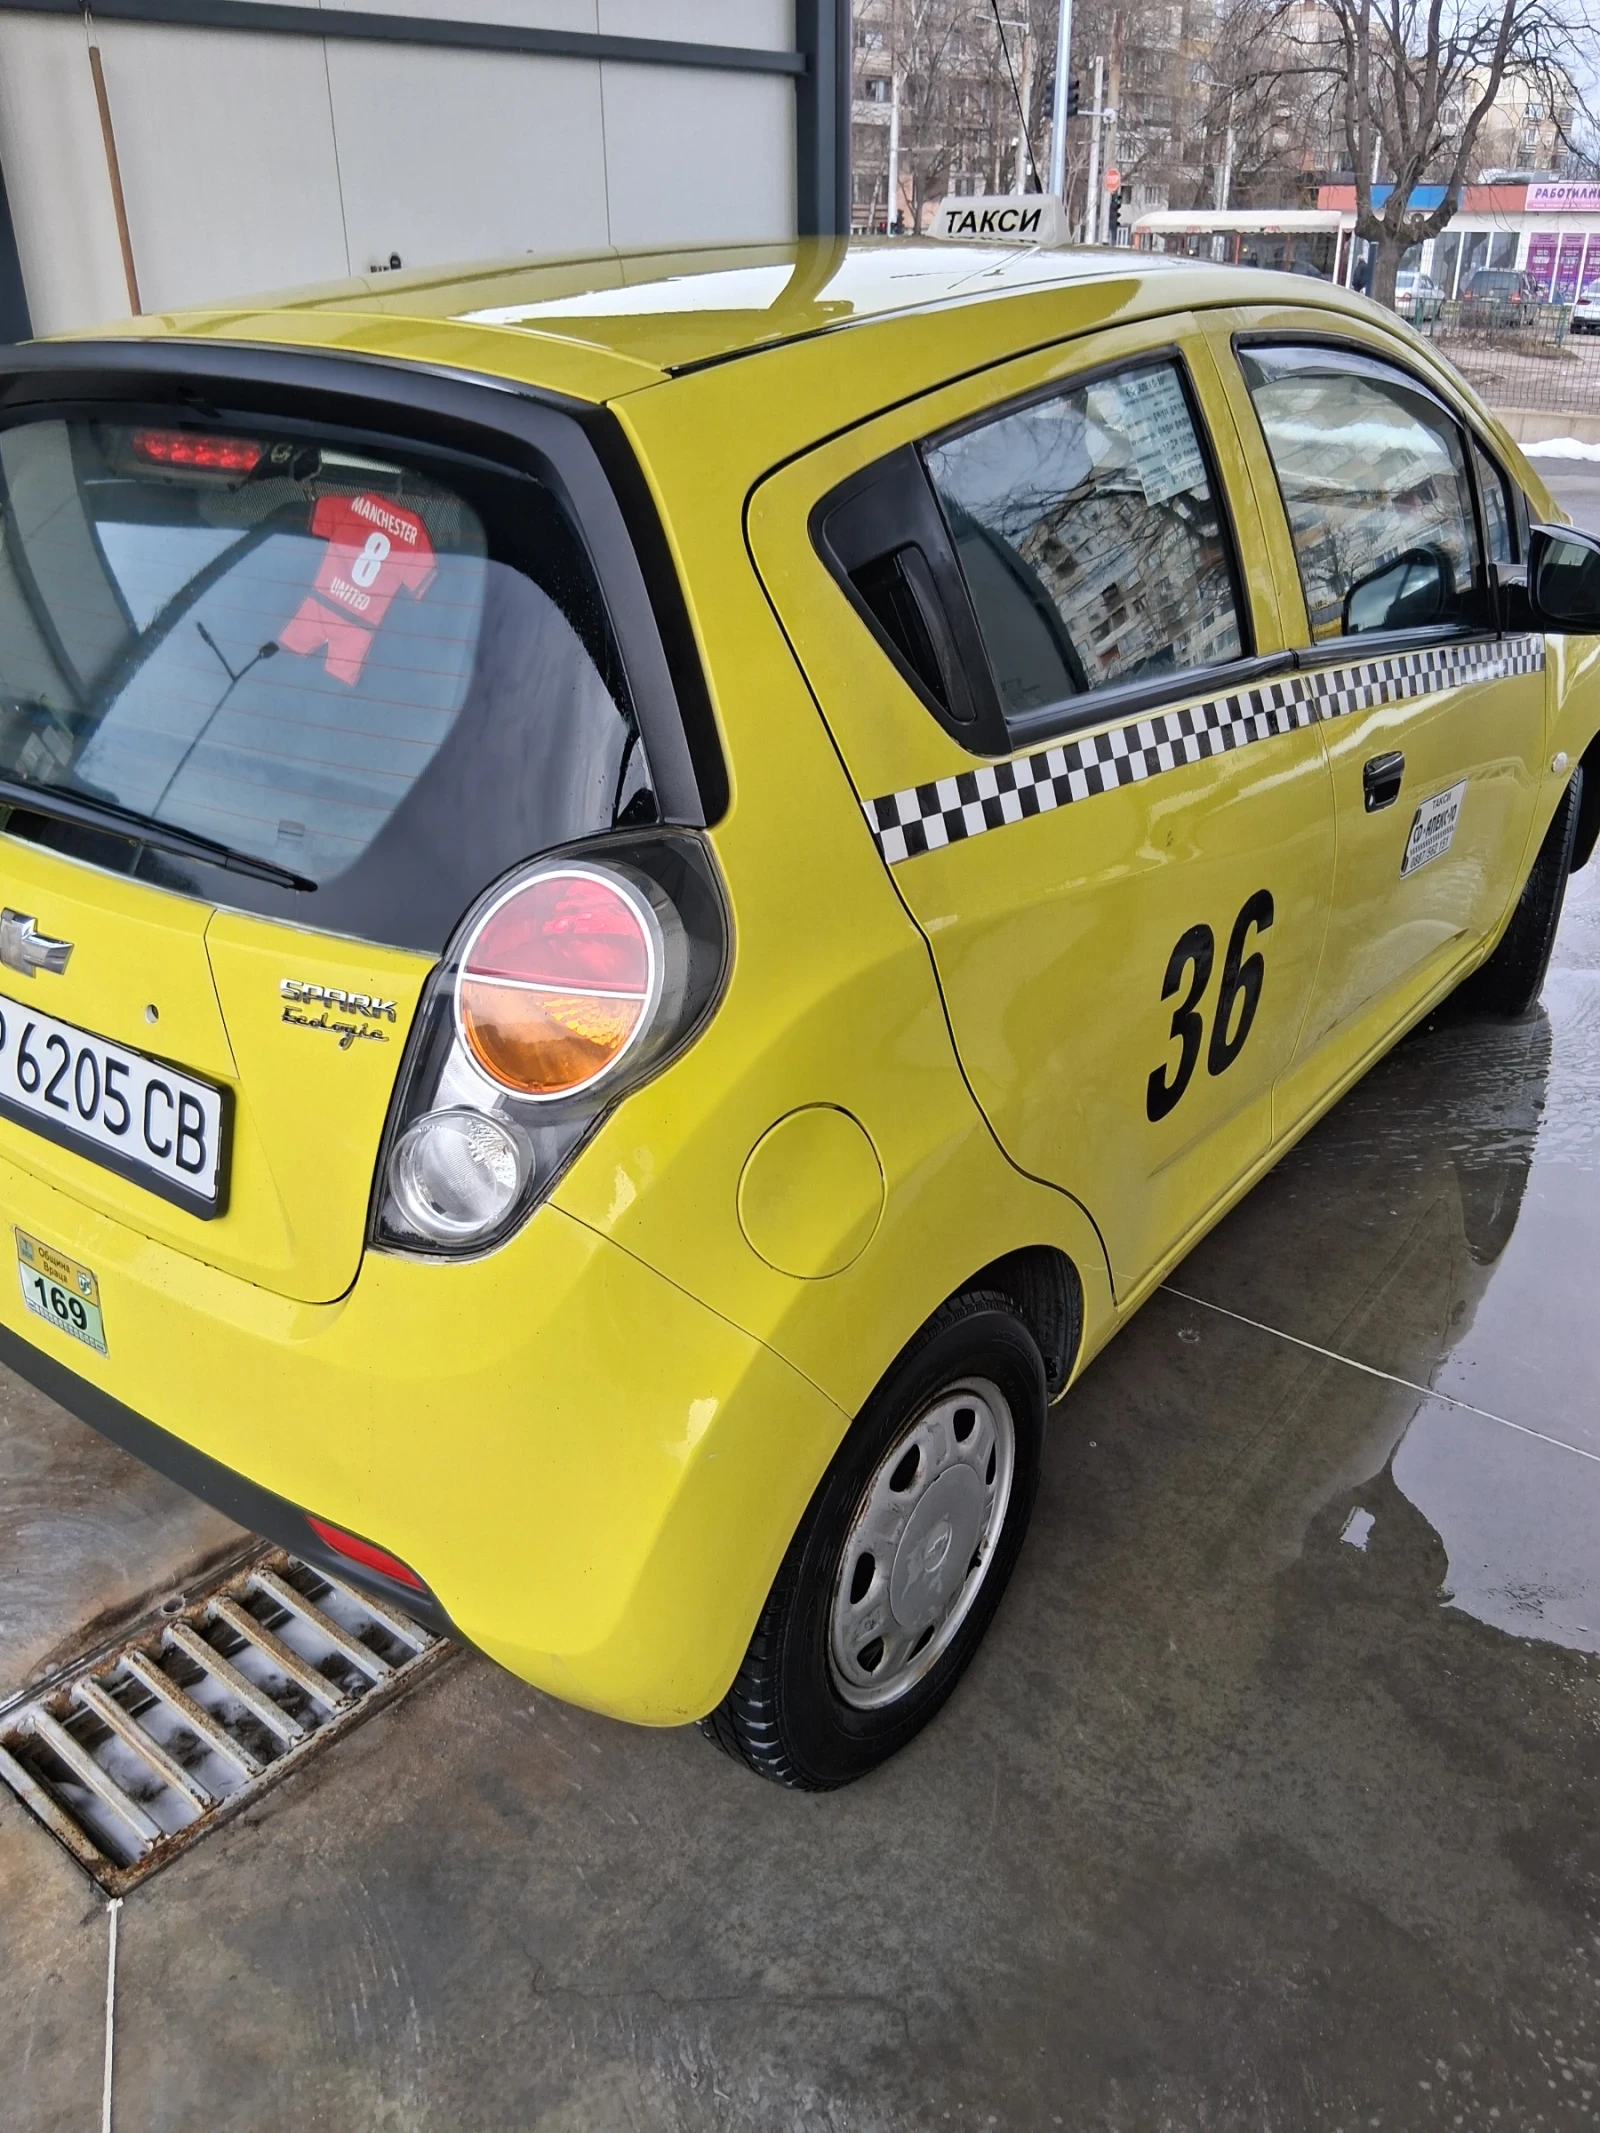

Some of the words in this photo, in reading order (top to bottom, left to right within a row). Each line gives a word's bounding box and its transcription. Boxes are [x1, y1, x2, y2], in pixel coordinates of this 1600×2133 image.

[1535, 188, 1600, 199] РАБОТИЛН
[946, 208, 1042, 234] ТАКСИ
[351, 496, 418, 546] MANCHESTER
[351, 532, 391, 587] 8
[330, 576, 371, 611] UNITED
[280, 978, 397, 1023] SPARK
[1146, 888, 1275, 1123] 36
[282, 1005, 389, 1050] Ecologic
[17, 1022, 131, 1136] 6205
[143, 1078, 207, 1175] CB
[38, 1247, 70, 1273] Община
[43, 1261, 68, 1284] Враца
[34, 1276, 88, 1331] 169
